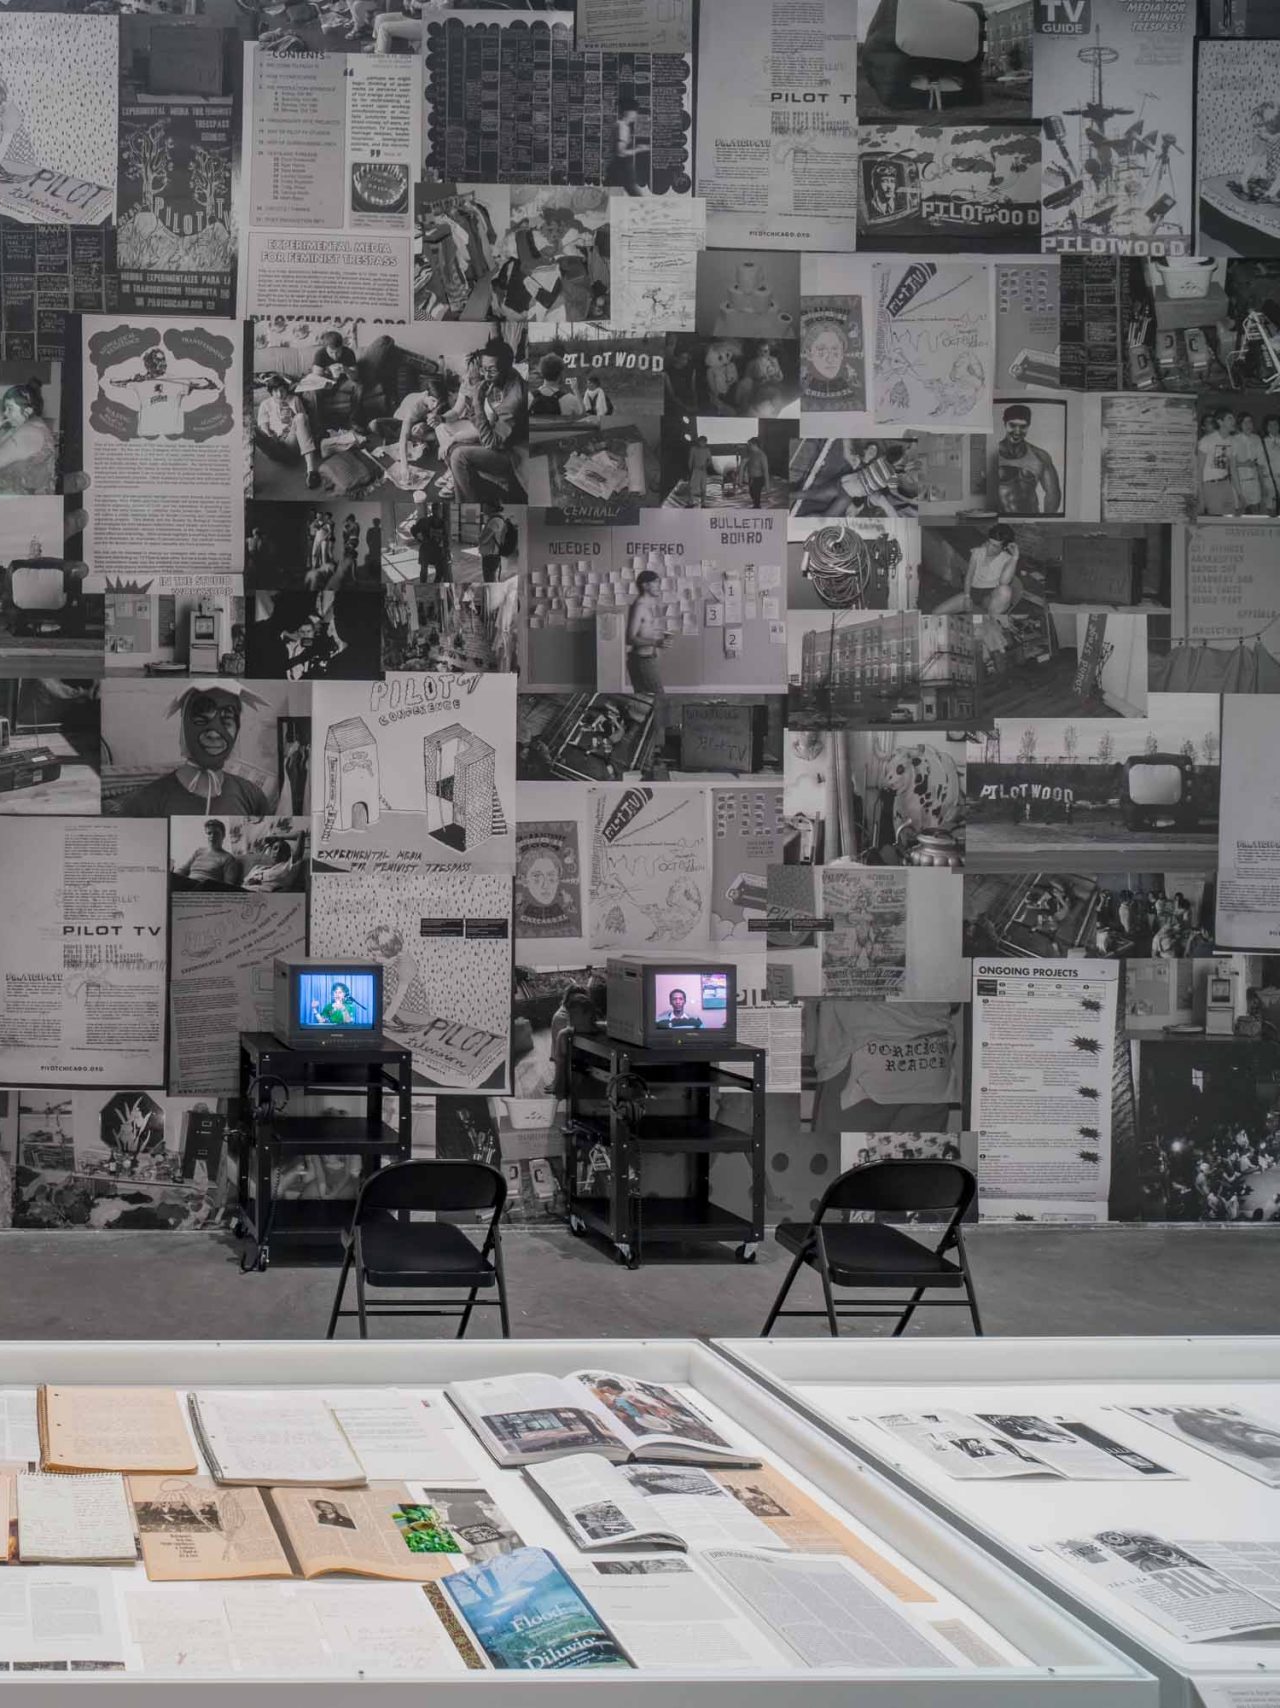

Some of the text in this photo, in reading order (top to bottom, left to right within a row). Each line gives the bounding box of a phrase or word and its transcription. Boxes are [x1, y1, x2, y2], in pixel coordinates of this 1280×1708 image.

[1041, 0, 1086, 22] TV
[1127, 3, 1185, 12] MEDIA FOR
[1138, 12, 1185, 21] FEMINIST
[1042, 23, 1083, 34] GUIDE
[272, 50, 326, 60] CONTENTS
[771, 92, 830, 104] PILOT
[267, 239, 392, 254] EXPERIMENTAL MEDIA
[262, 252, 398, 266] FOR FEMINIST TRESPASS
[709, 517, 773, 530] BULLETIN
[548, 541, 601, 555] NEEDED
[626, 541, 685, 555] OFFERED
[708, 609, 716, 621] 3
[728, 634, 737, 646] 2
[369, 674, 456, 712] PILOT
[63, 926, 162, 937] PILOT TV
[979, 966, 1079, 978] ONGOING PROJECTS
